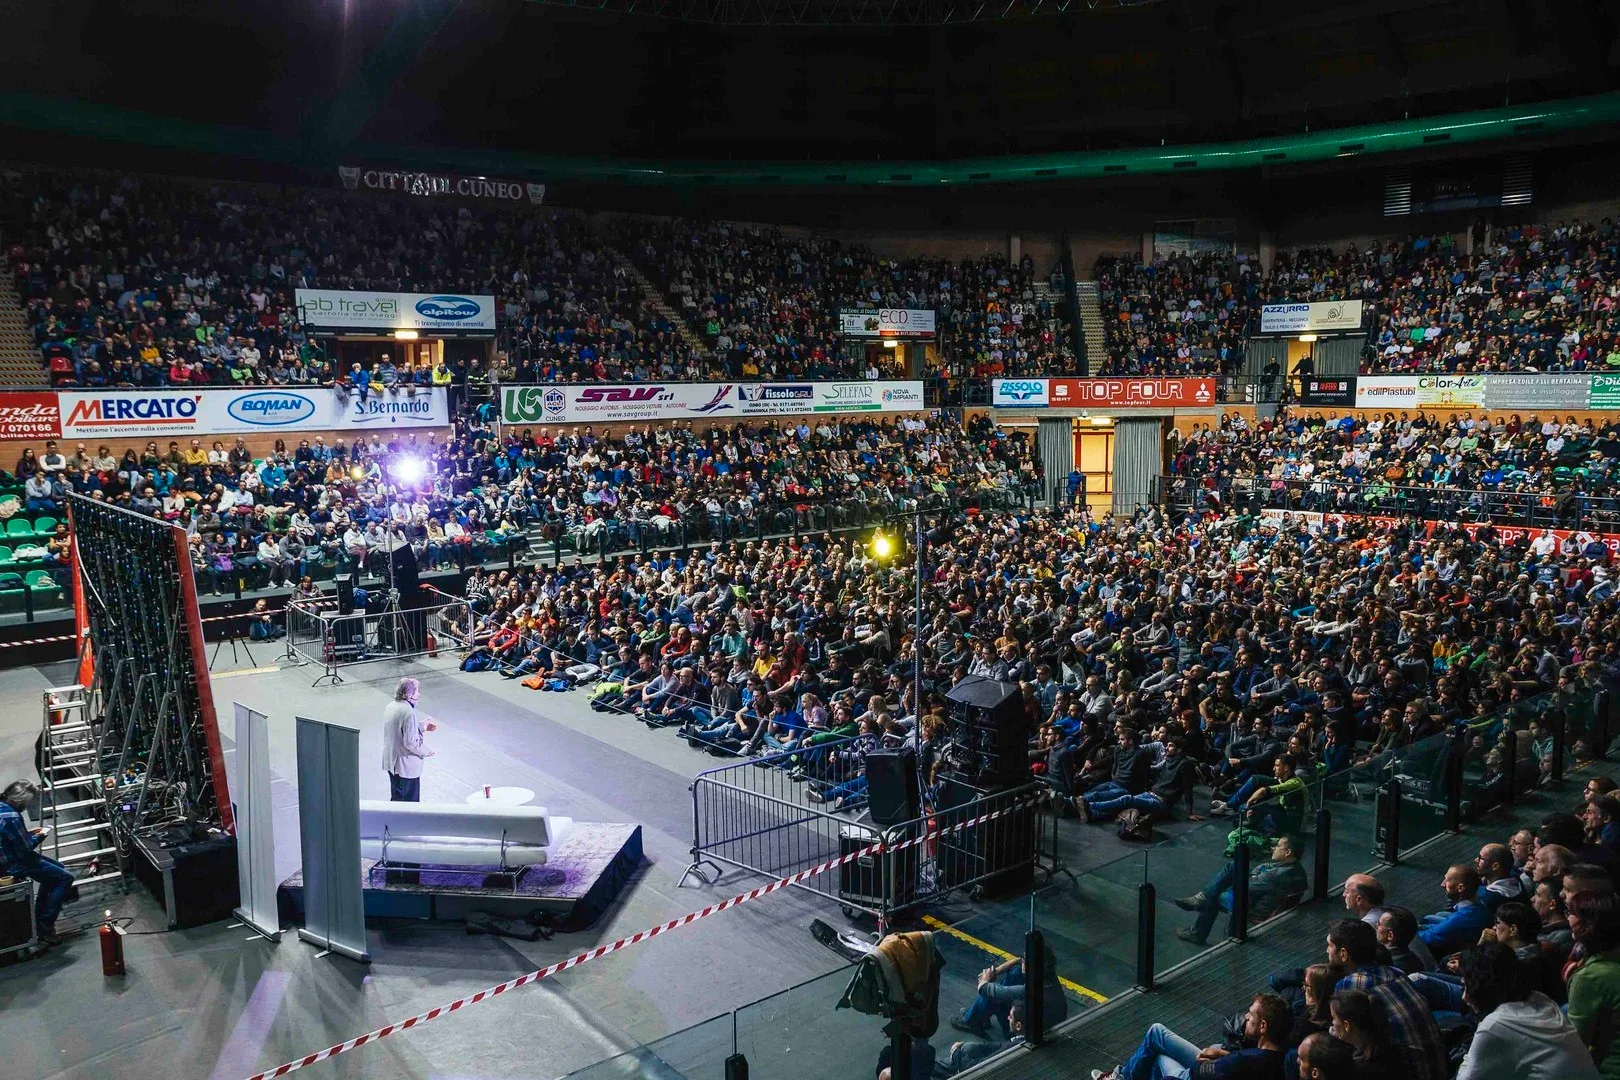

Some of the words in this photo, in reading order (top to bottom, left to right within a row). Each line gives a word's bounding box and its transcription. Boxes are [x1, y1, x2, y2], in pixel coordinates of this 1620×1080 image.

[457, 178, 523, 200] CUNEO
[339, 297, 398, 313] travel
[422, 308, 475, 317] alpitour
[421, 320, 454, 328] travolgiamo
[999, 381, 1043, 391] FISSOLO
[1078, 381, 1123, 400] TOP
[1126, 380, 1183, 400] FOUR
[822, 383, 873, 400] SELEFAR
[1367, 387, 1416, 396] edilPlastubi
[658, 392, 674, 401] srl
[0, 403, 58, 416] nda
[607, 410, 658, 419] www.savgroup.it
[8, 424, 52, 432] 070166
